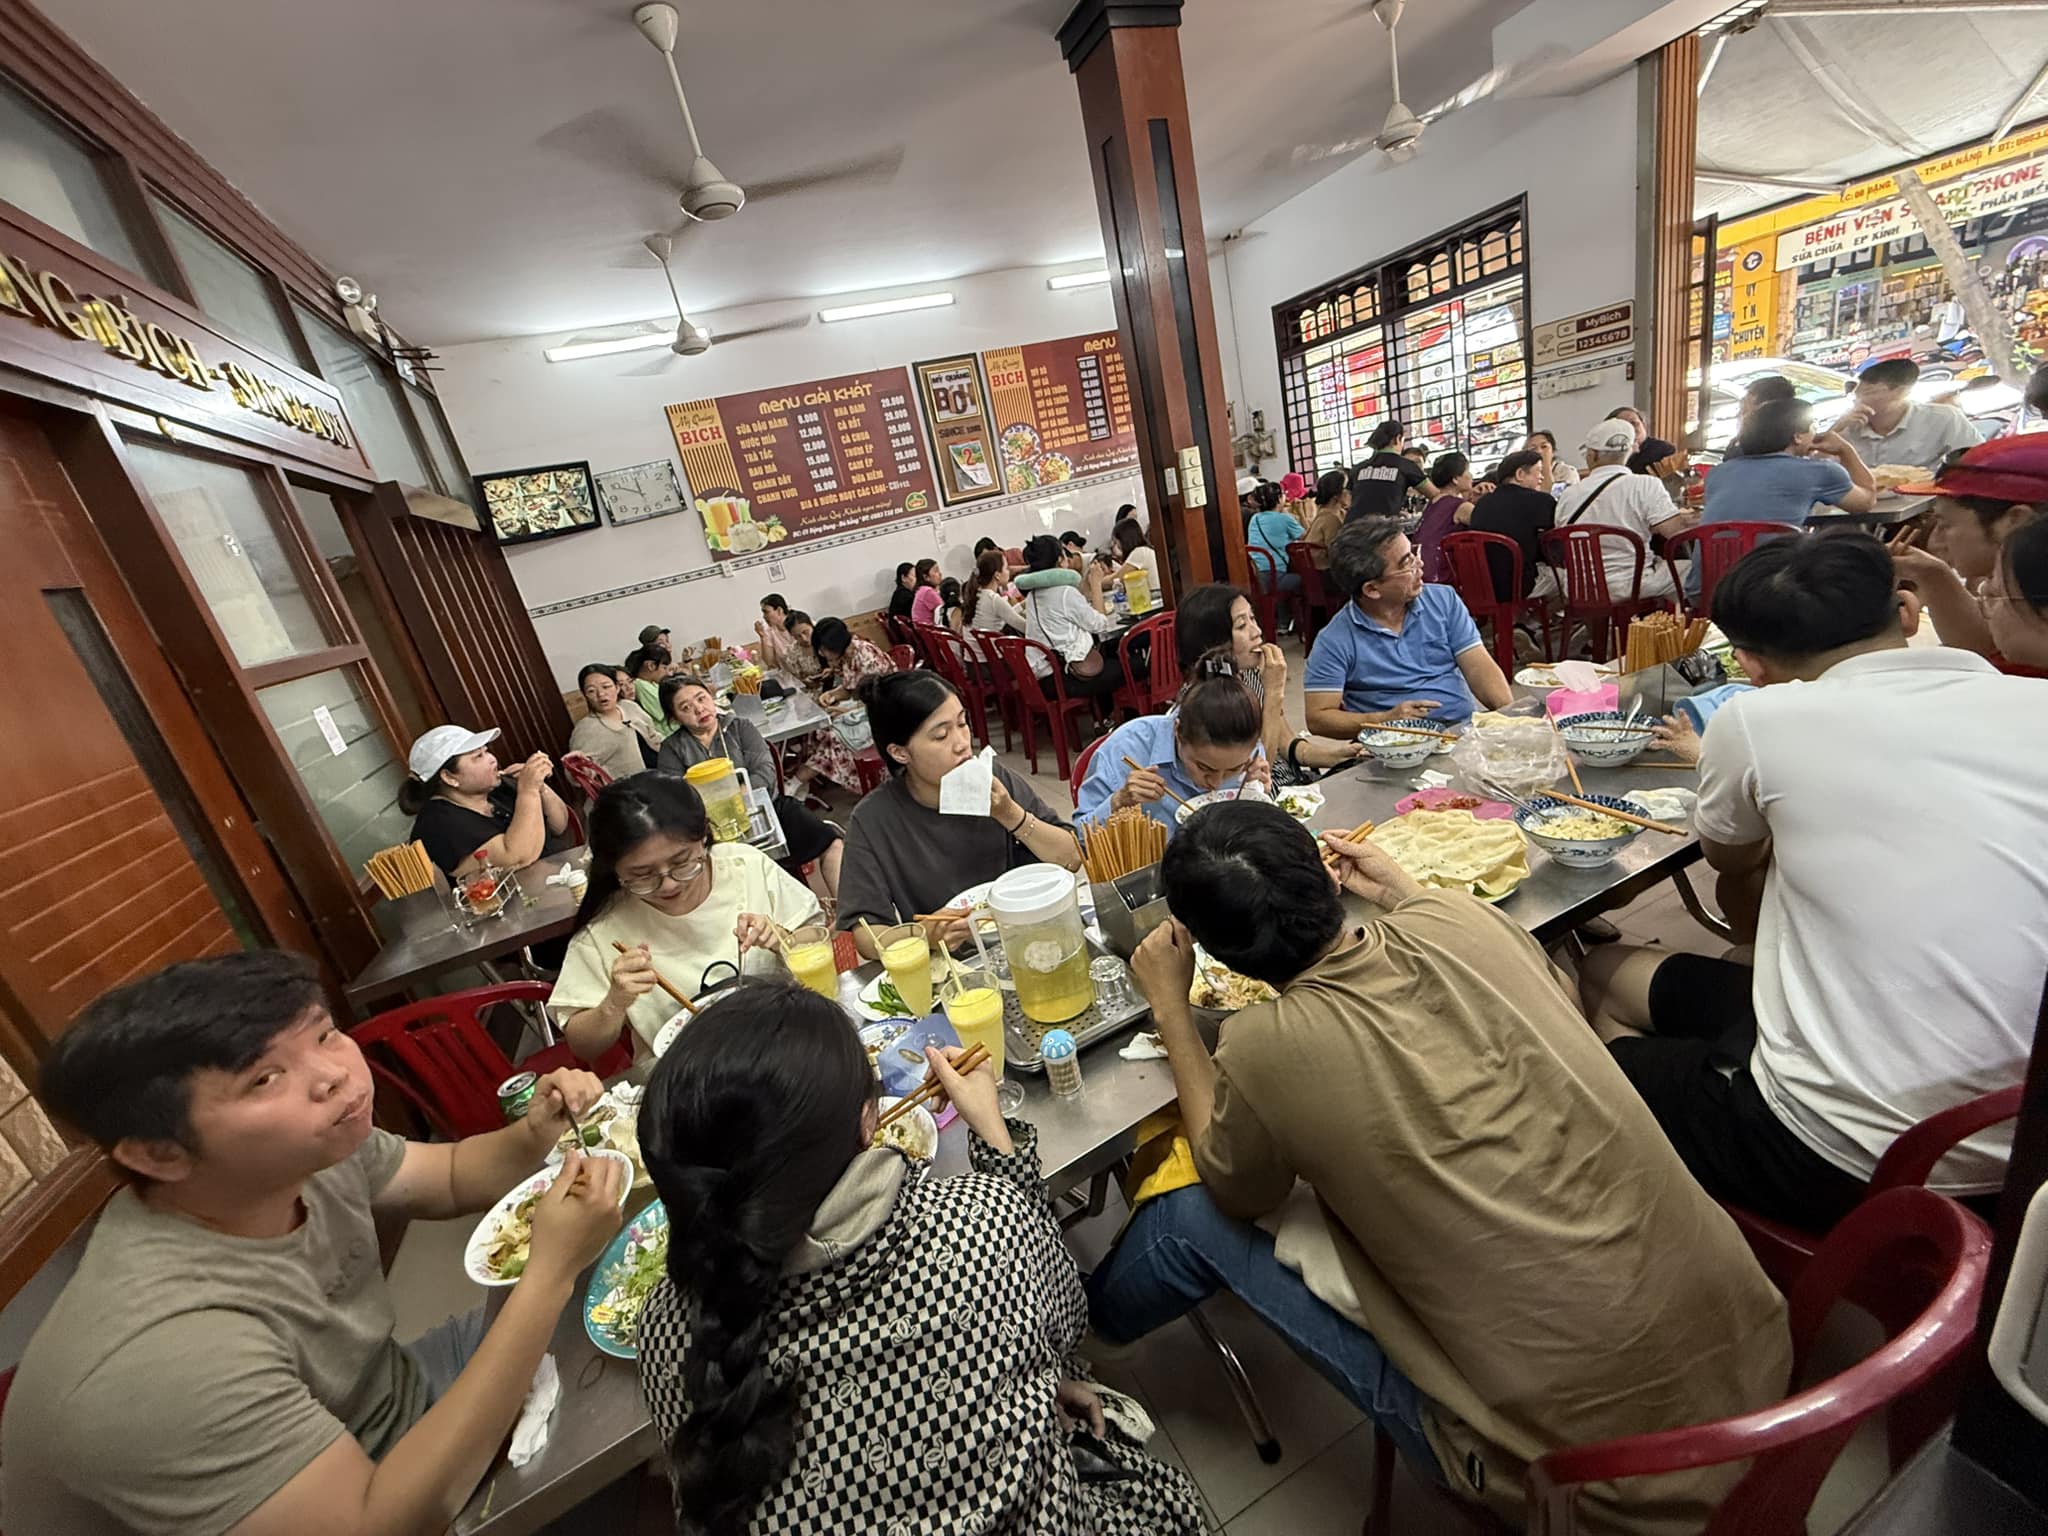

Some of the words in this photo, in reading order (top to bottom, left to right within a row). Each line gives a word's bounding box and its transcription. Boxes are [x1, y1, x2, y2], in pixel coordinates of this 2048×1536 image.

[1804, 221, 1847, 246] BỆNH
[1854, 206, 1894, 231] VIỆN
[1899, 161, 2044, 218] SARTPHONE
[1584, 310, 1623, 328] MyBich
[1578, 329, 1629, 349] 12345678
